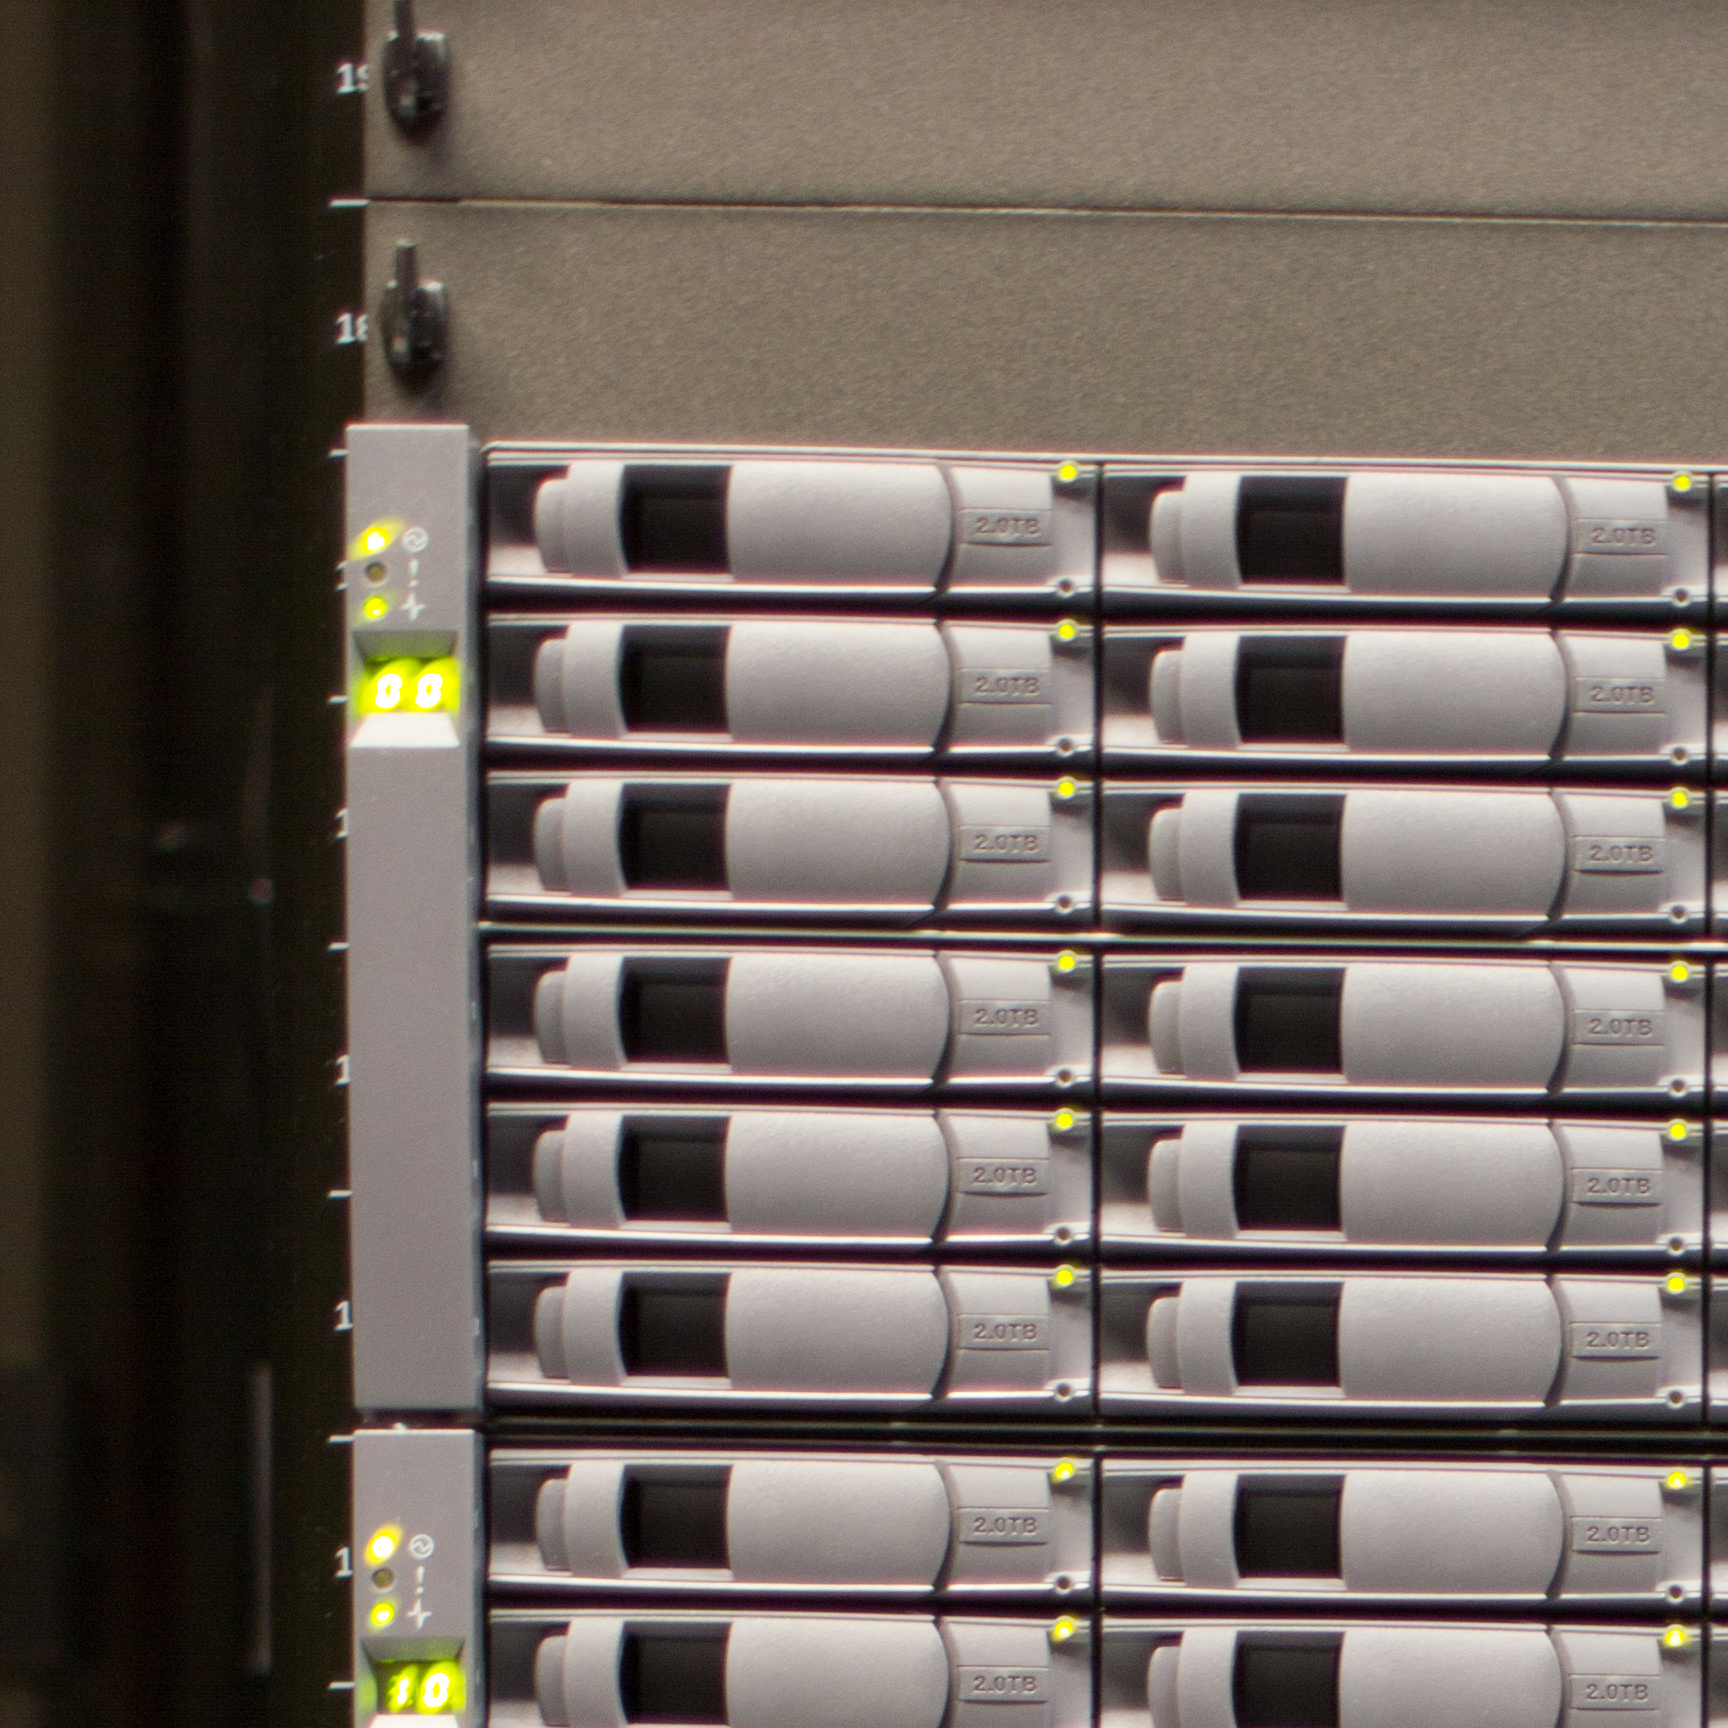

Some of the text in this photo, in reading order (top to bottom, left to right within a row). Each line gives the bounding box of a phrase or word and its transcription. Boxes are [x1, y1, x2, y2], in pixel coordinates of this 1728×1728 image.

[975, 516, 1040, 535] 2.0TB
[1592, 525, 1657, 544] 2.0TB
[975, 675, 1040, 695] 2.0TB
[1590, 684, 1655, 704] 2.0TB
[974, 832, 1039, 851] 2.0TB
[1589, 843, 1654, 862] 2.0TB
[974, 1007, 1039, 1026] 2.0TB
[1588, 1016, 1653, 1036] 2.0TB
[972, 1165, 1037, 1185] 2.0TB
[1587, 1175, 1652, 1194] 2.0TB
[973, 1321, 1038, 1341] 2.0TB
[1586, 1329, 1651, 1348] 2.0TB
[973, 1515, 1038, 1534] 2.0TB
[1586, 1523, 1651, 1543] 2.0TB
[973, 1673, 1038, 1693] 2.0TB
[1584, 1681, 1649, 1701] 2.0TB
